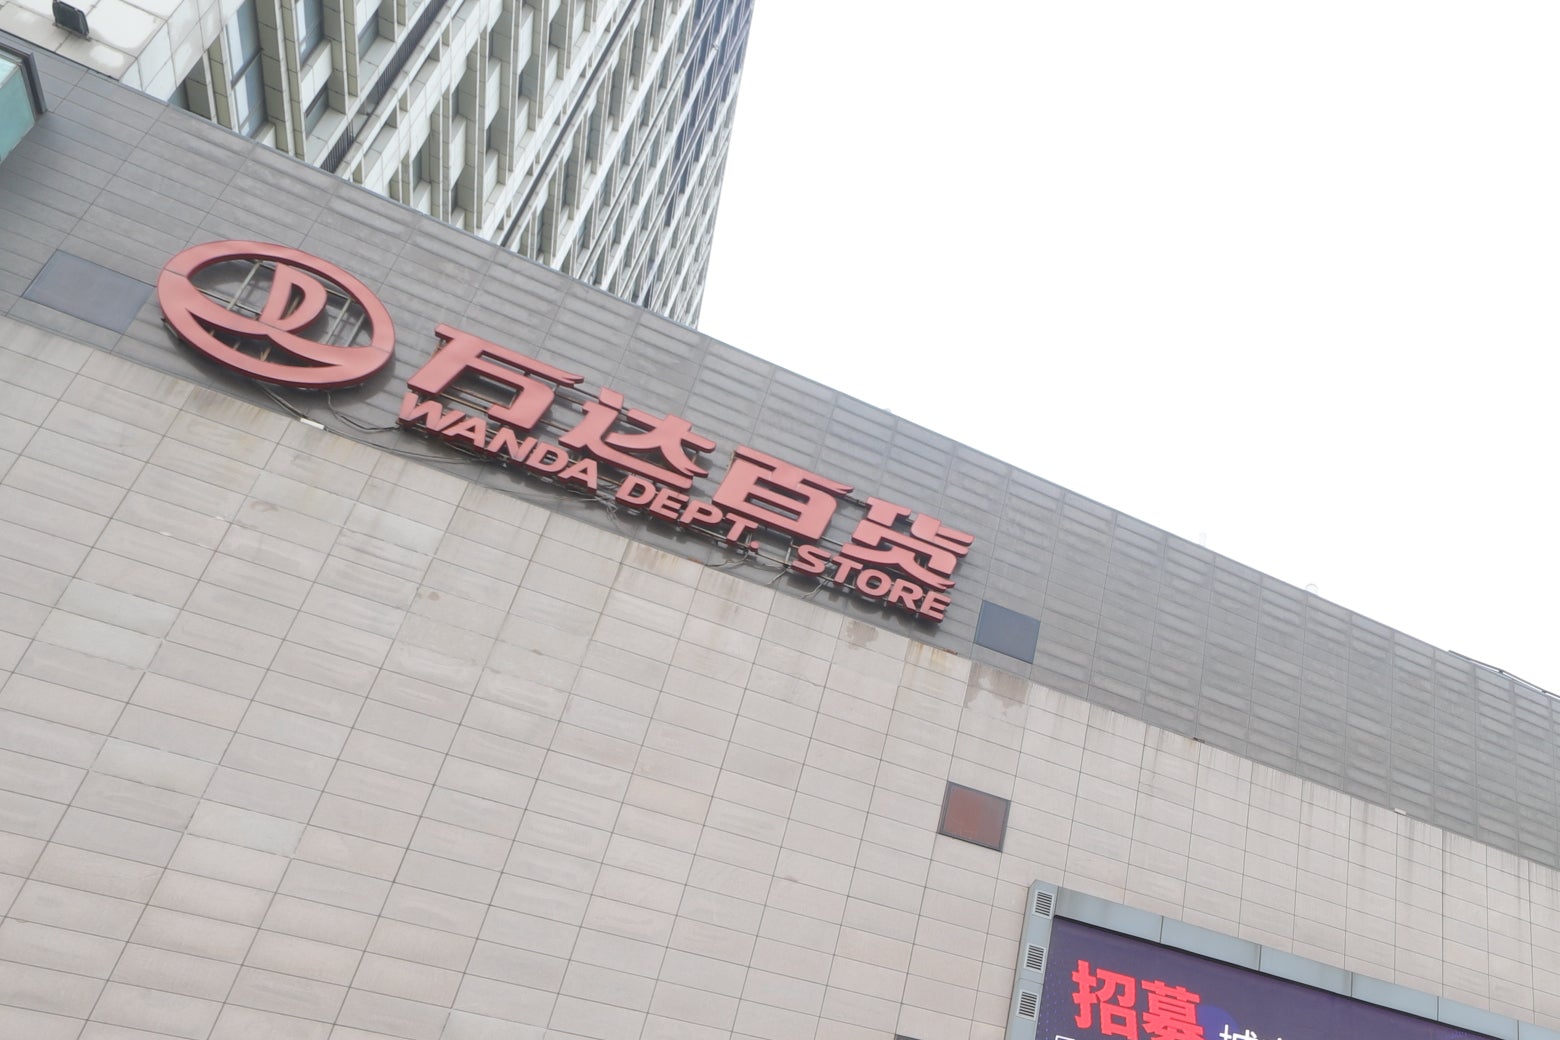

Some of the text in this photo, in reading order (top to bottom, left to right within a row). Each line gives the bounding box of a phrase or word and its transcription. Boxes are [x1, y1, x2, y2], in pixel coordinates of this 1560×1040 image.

[399, 391, 951, 623] WANDA DEPT. STORE
[407, 322, 975, 592] 万达百货
